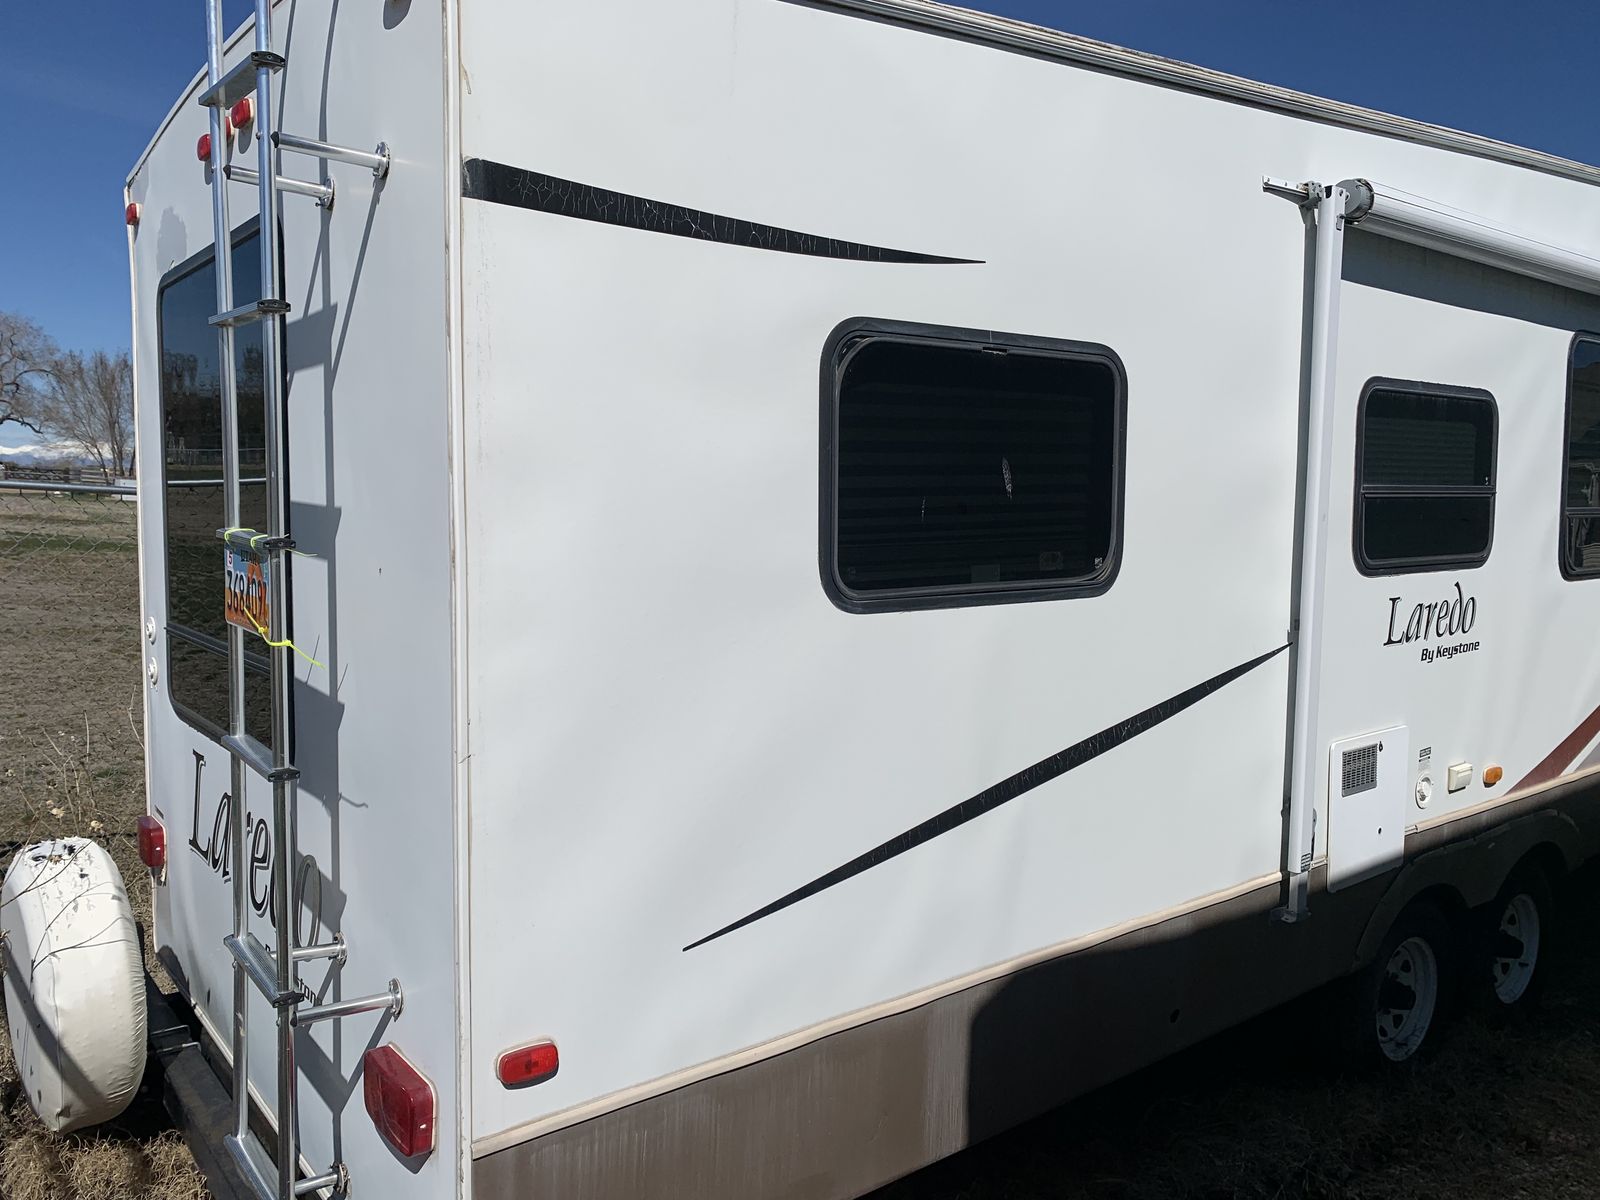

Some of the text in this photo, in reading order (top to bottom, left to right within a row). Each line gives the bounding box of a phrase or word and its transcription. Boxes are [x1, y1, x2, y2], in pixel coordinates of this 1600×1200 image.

[1383, 581, 1477, 646] Laredo
[1420, 641, 1480, 664] By Keystone
[189, 749, 322, 961] Laeo
